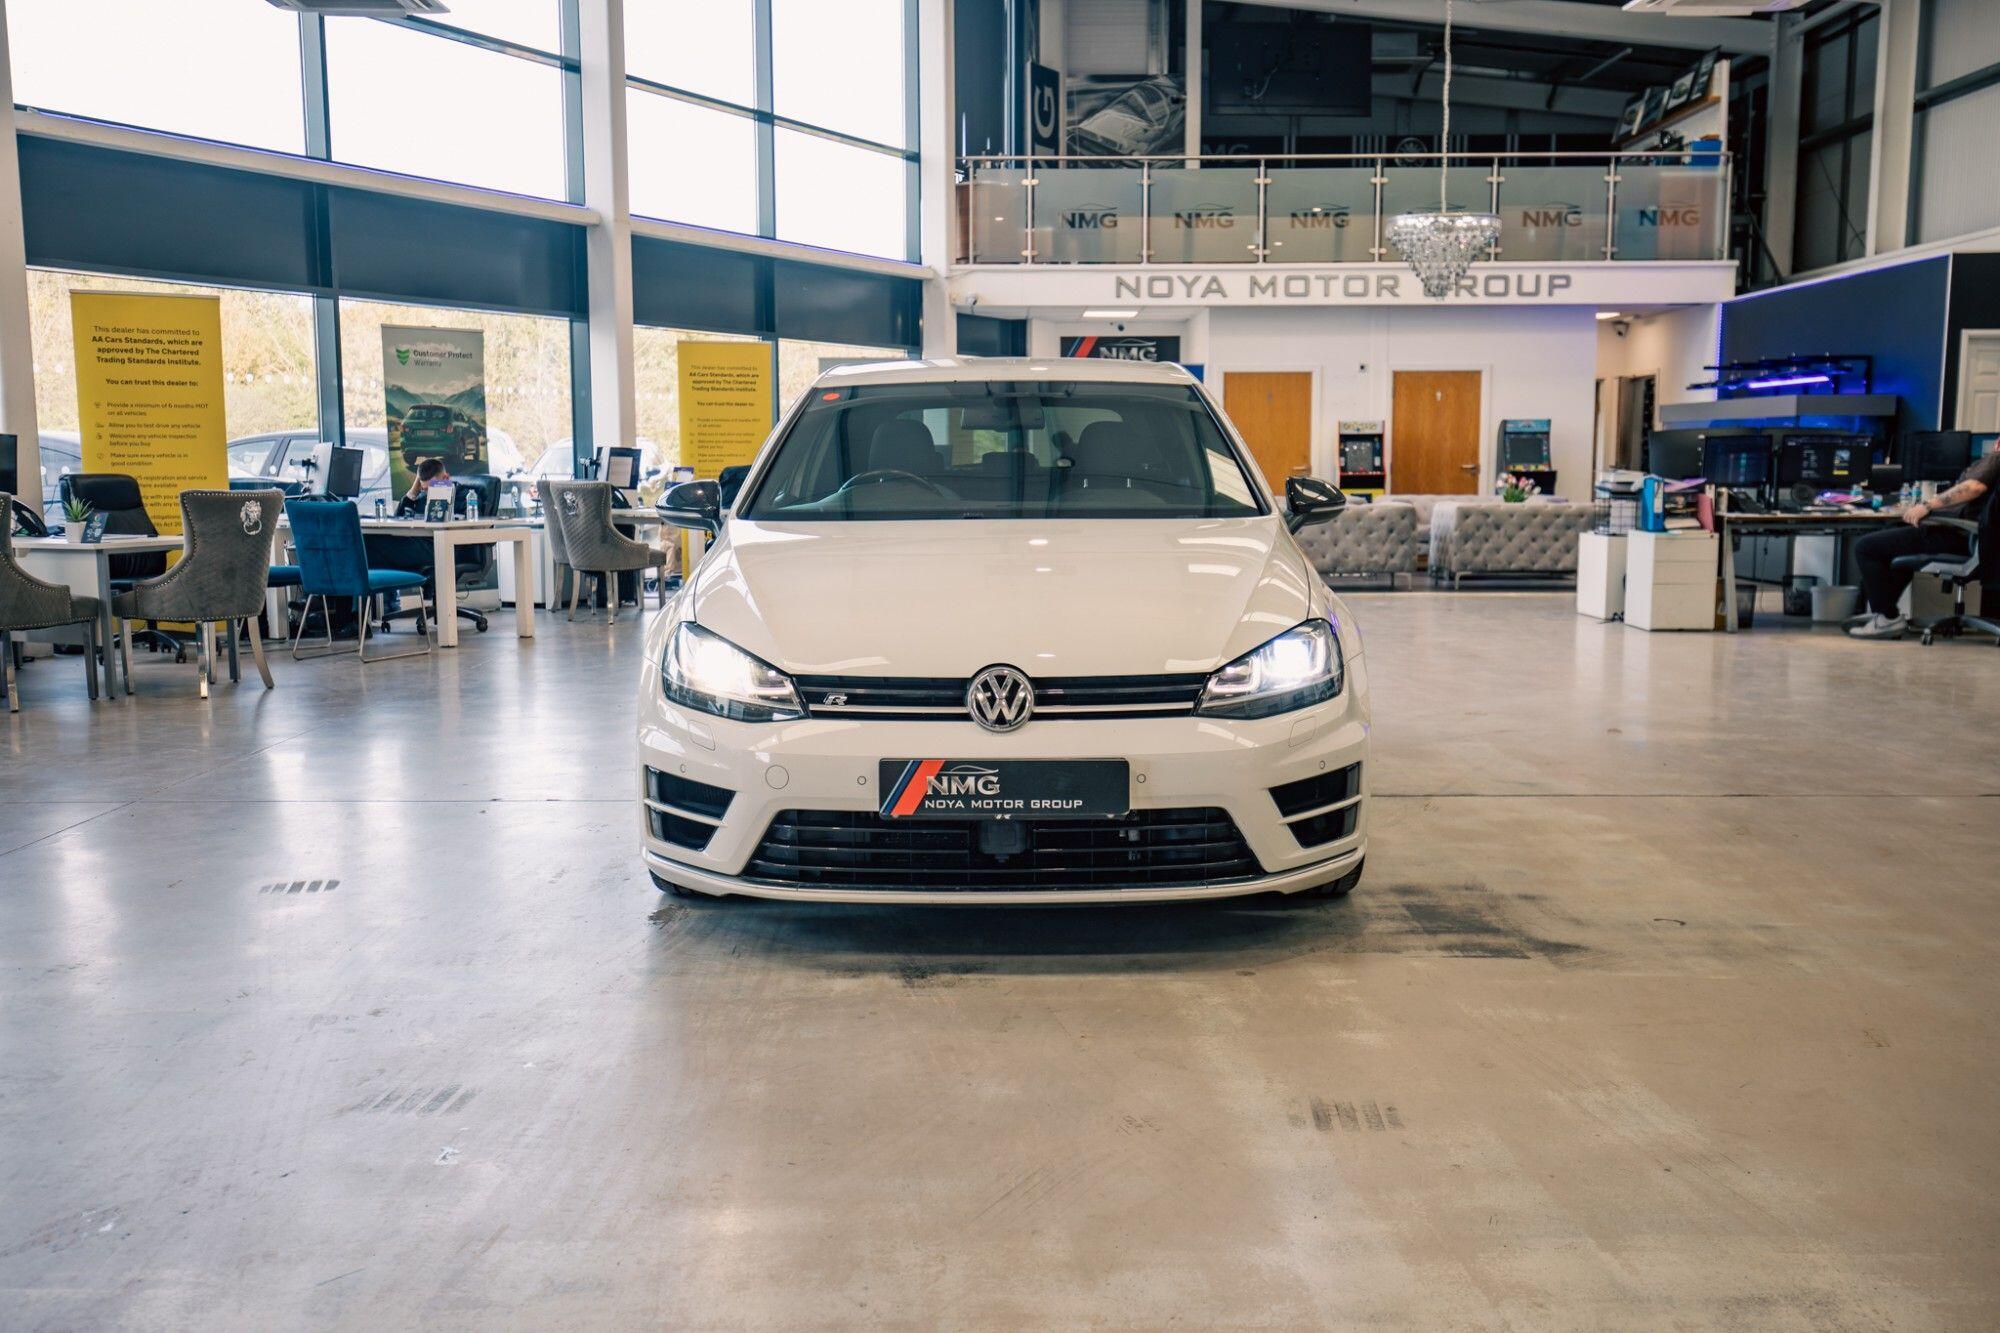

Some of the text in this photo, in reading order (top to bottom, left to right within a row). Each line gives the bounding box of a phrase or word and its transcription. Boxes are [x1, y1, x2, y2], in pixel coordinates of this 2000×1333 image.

[1060, 212, 1118, 229] NMG
[1174, 212, 1235, 229] NMG
[1290, 212, 1350, 229] NMG
[1522, 210, 1582, 227] NMG
[1639, 208, 1699, 226] NMG
[1115, 275, 1228, 298] NOYA
[1249, 275, 1401, 298] MOTOR
[151, 328, 190, 336] committed
[124, 336, 166, 346] Standards,
[96, 356, 201, 366] Trading Standards Institute.
[413, 350, 446, 358] Customer
[1100, 347, 1158, 361] NMG
[925, 775, 1000, 796] NMG
[925, 799, 1083, 809] NOYA MOTOR GROUP
